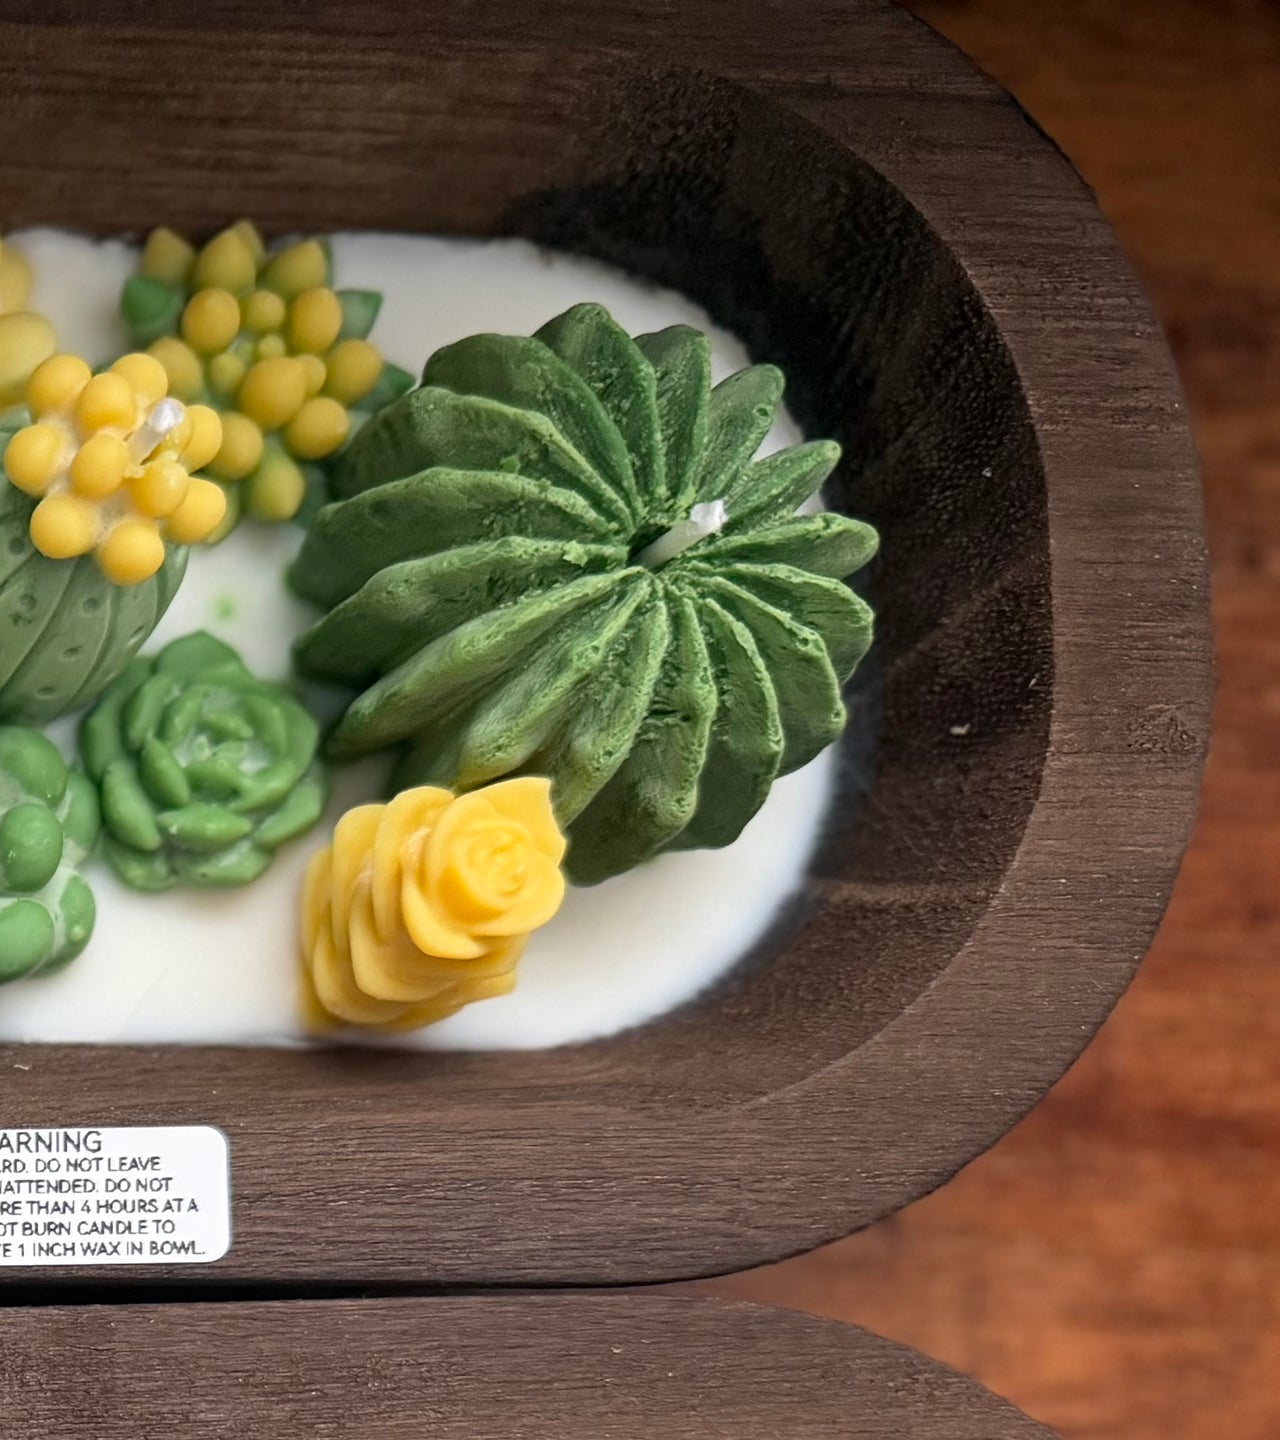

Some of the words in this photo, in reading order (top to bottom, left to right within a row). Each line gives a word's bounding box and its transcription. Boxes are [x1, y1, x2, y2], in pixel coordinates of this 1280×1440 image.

[35, 1157, 60, 1173] DO
[66, 1157, 104, 1173] NOT
[107, 1156, 161, 1173] LEAVE
[104, 1178, 131, 1194] DO
[136, 1177, 173, 1193] NOT
[26, 1200, 75, 1217] THAN
[80, 1199, 92, 1216] 4
[96, 1198, 158, 1215] HOURS
[161, 1198, 183, 1214] AT
[187, 1197, 199, 1214] A
[22, 1221, 71, 1238] BURN
[77, 1220, 148, 1237] CANDLE
[149, 1219, 176, 1236] TO
[17, 1242, 26, 1258] 1
[32, 1242, 76, 1258] INCH
[79, 1241, 119, 1258] WAX
[126, 1241, 143, 1257] IN
[149, 1240, 207, 1257] BOWL.
